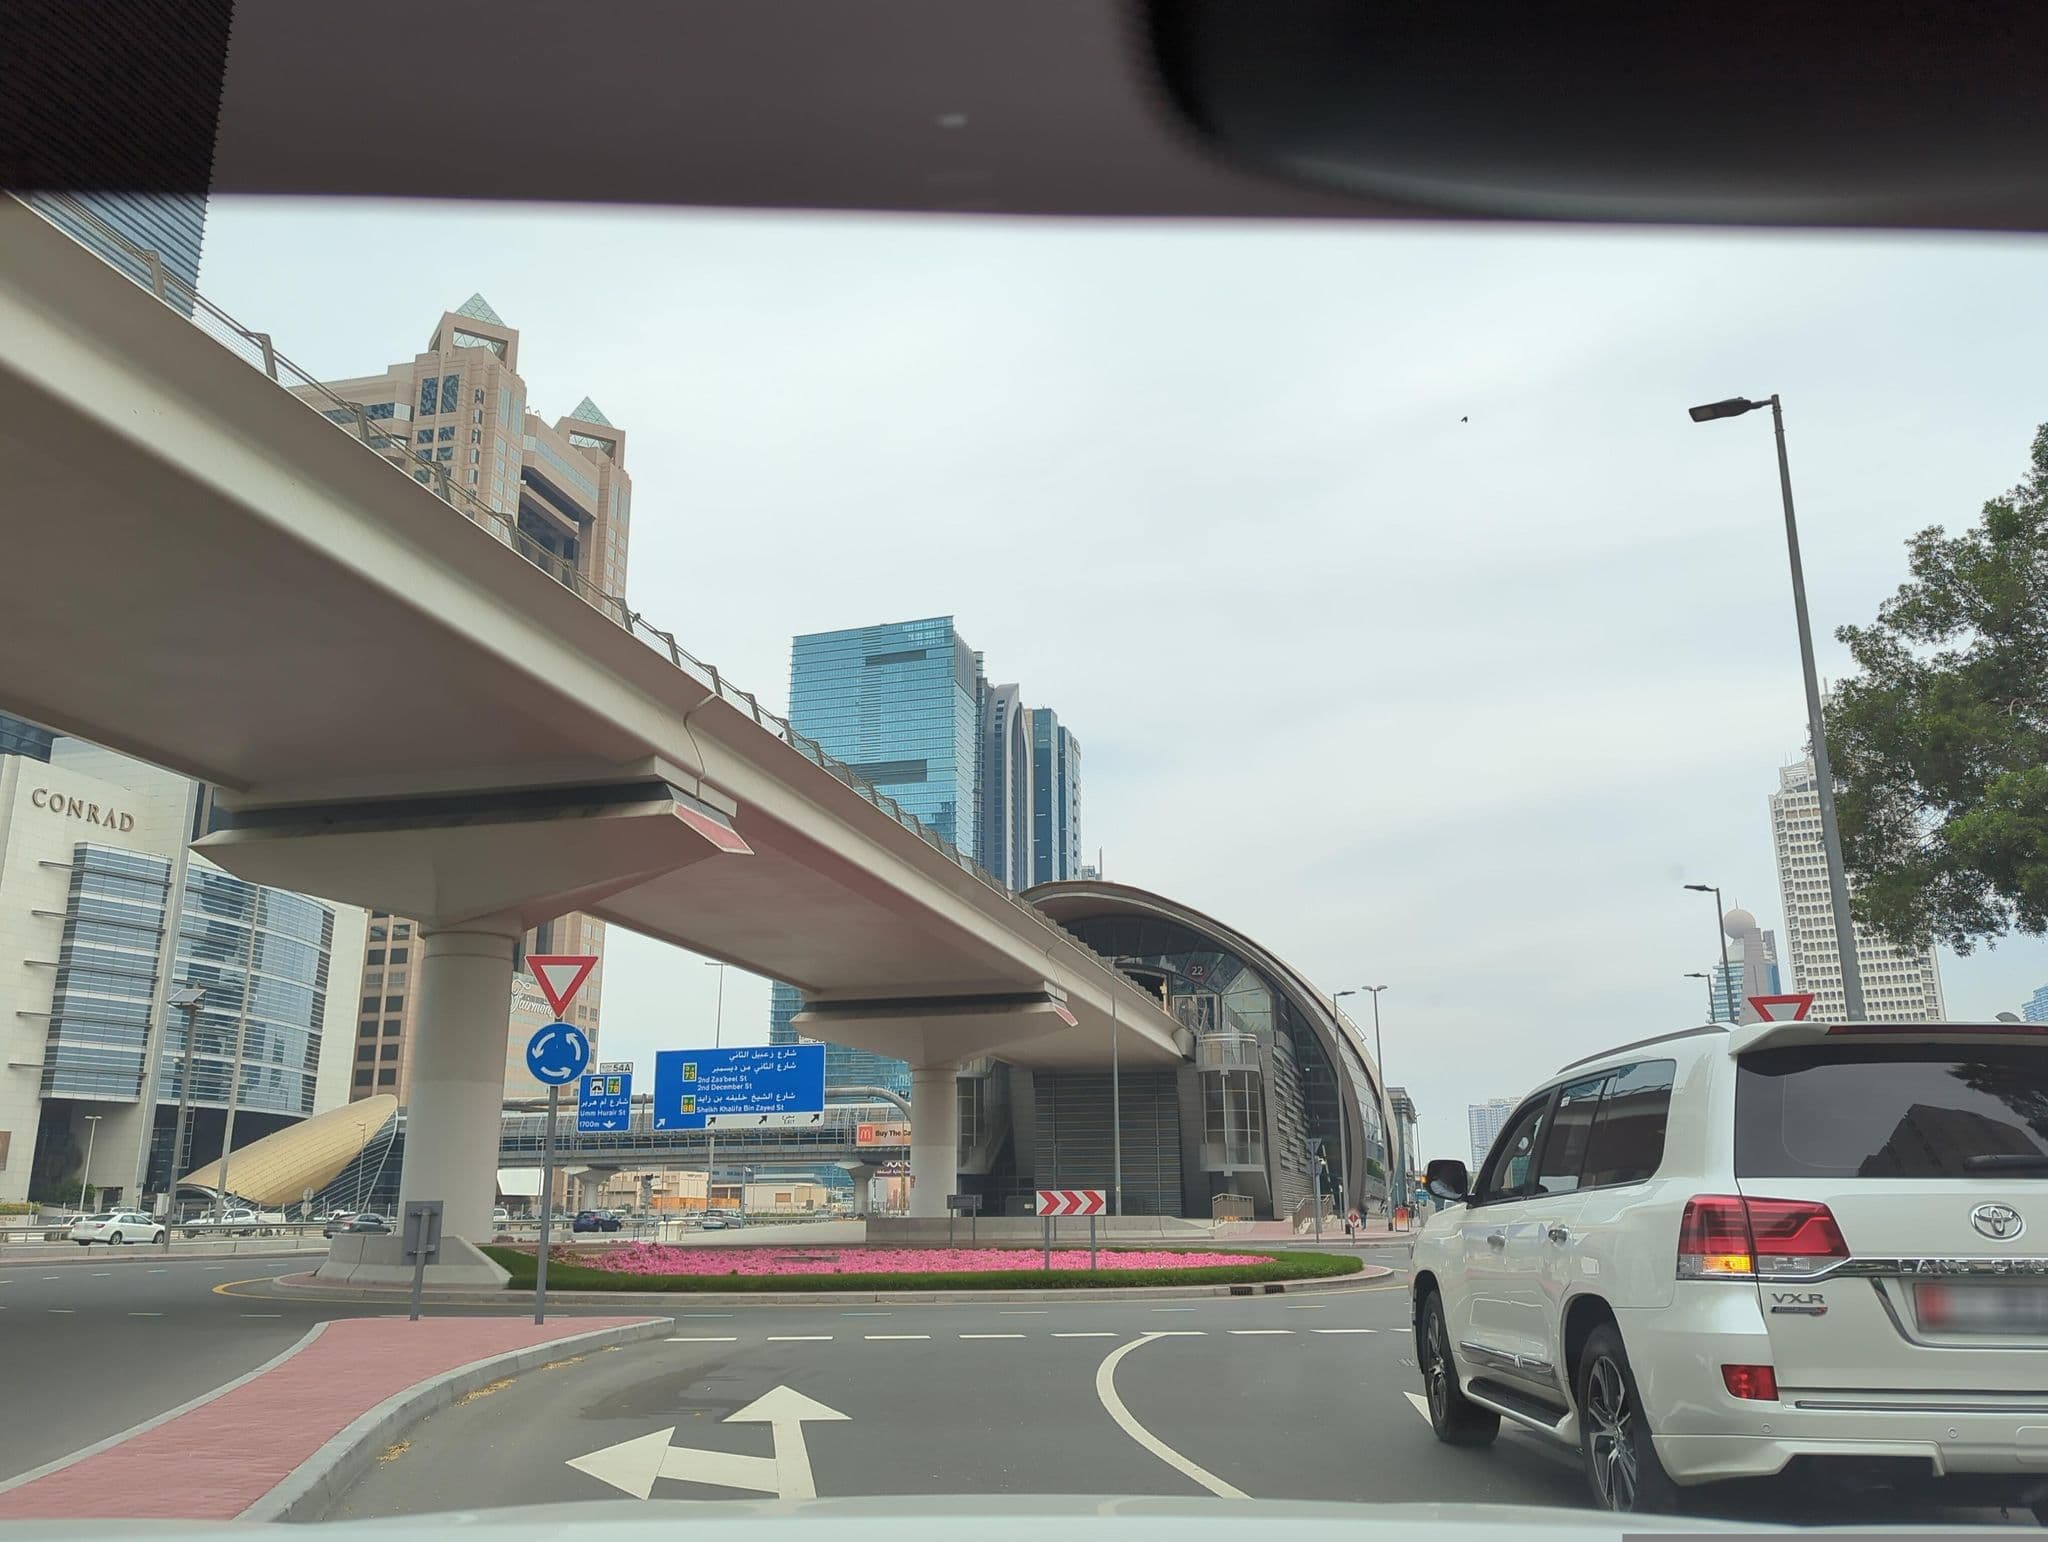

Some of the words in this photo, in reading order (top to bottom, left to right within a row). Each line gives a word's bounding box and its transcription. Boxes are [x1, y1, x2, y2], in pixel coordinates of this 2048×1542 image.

[32, 788, 135, 832] CONRAD
[1191, 966, 1204, 976] 22
[729, 1051, 749, 1063] الثاني
[777, 1048, 797, 1059] شارع
[613, 1064, 631, 1072] 54A
[753, 1063, 774, 1075] الثاني
[776, 1062, 797, 1071] شارع
[713, 1095, 723, 1103] بن
[751, 1092, 773, 1103] الشيخ
[776, 1091, 796, 1102] شارع
[609, 1097, 629, 1107] شارع
[597, 1109, 617, 1117] Hurair
[618, 1108, 626, 1116] St
[696, 1105, 718, 1113] Sheikh
[719, 1104, 742, 1113] Khalifa
[755, 1103, 775, 1113] Zayed
[776, 1103, 785, 1111] St
[875, 1130, 888, 1138] Buy
[889, 1129, 901, 1137] The
[1771, 1293, 1825, 1304] VXR
